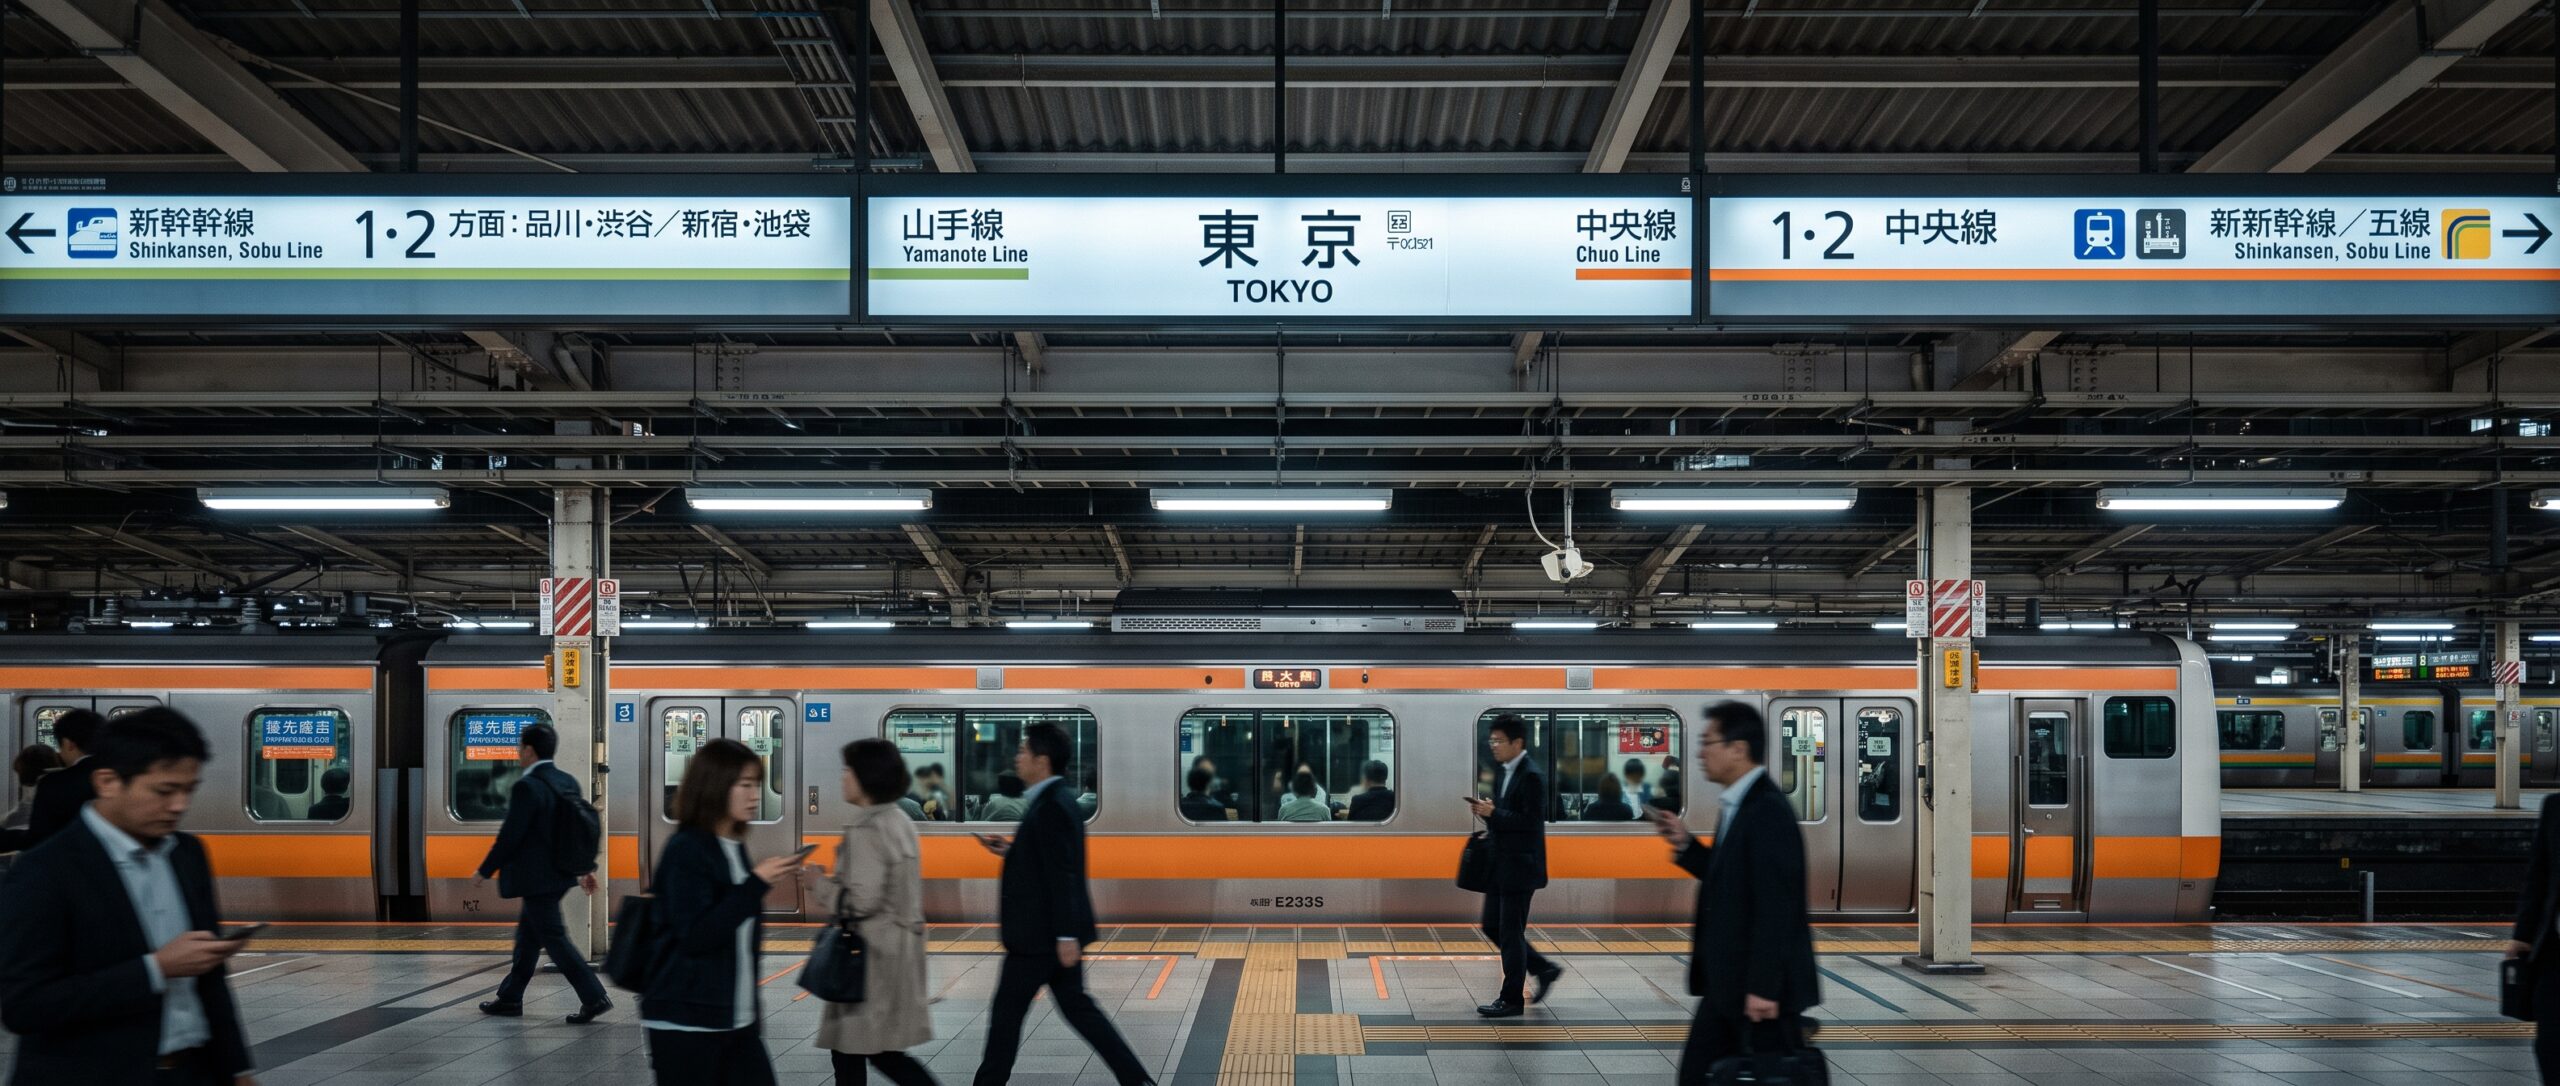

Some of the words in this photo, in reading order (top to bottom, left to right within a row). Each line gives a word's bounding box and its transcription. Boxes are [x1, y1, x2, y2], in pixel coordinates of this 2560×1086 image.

[129, 207, 256, 238] 新幹幹線
[903, 208, 1005, 241] 山手線
[1576, 208, 1678, 241] 中央線
[1885, 208, 1998, 246] 中央線
[1198, 207, 1362, 269] 東京
[129, 241, 234, 263] Shinkansen,
[239, 241, 282, 261] Sobu
[287, 241, 323, 261] Line
[903, 246, 987, 264] Yamanote
[993, 246, 1028, 263] Line
[1576, 245, 1619, 264] Chuo
[1625, 245, 1661, 264] Line
[2234, 242, 2339, 262] Shinkansen,
[2346, 242, 2389, 261] Sobu
[2395, 242, 2431, 261] Line
[1226, 279, 1334, 304] TOKYO
[821, 707, 828, 718] E
[1275, 896, 1324, 908] E233S
